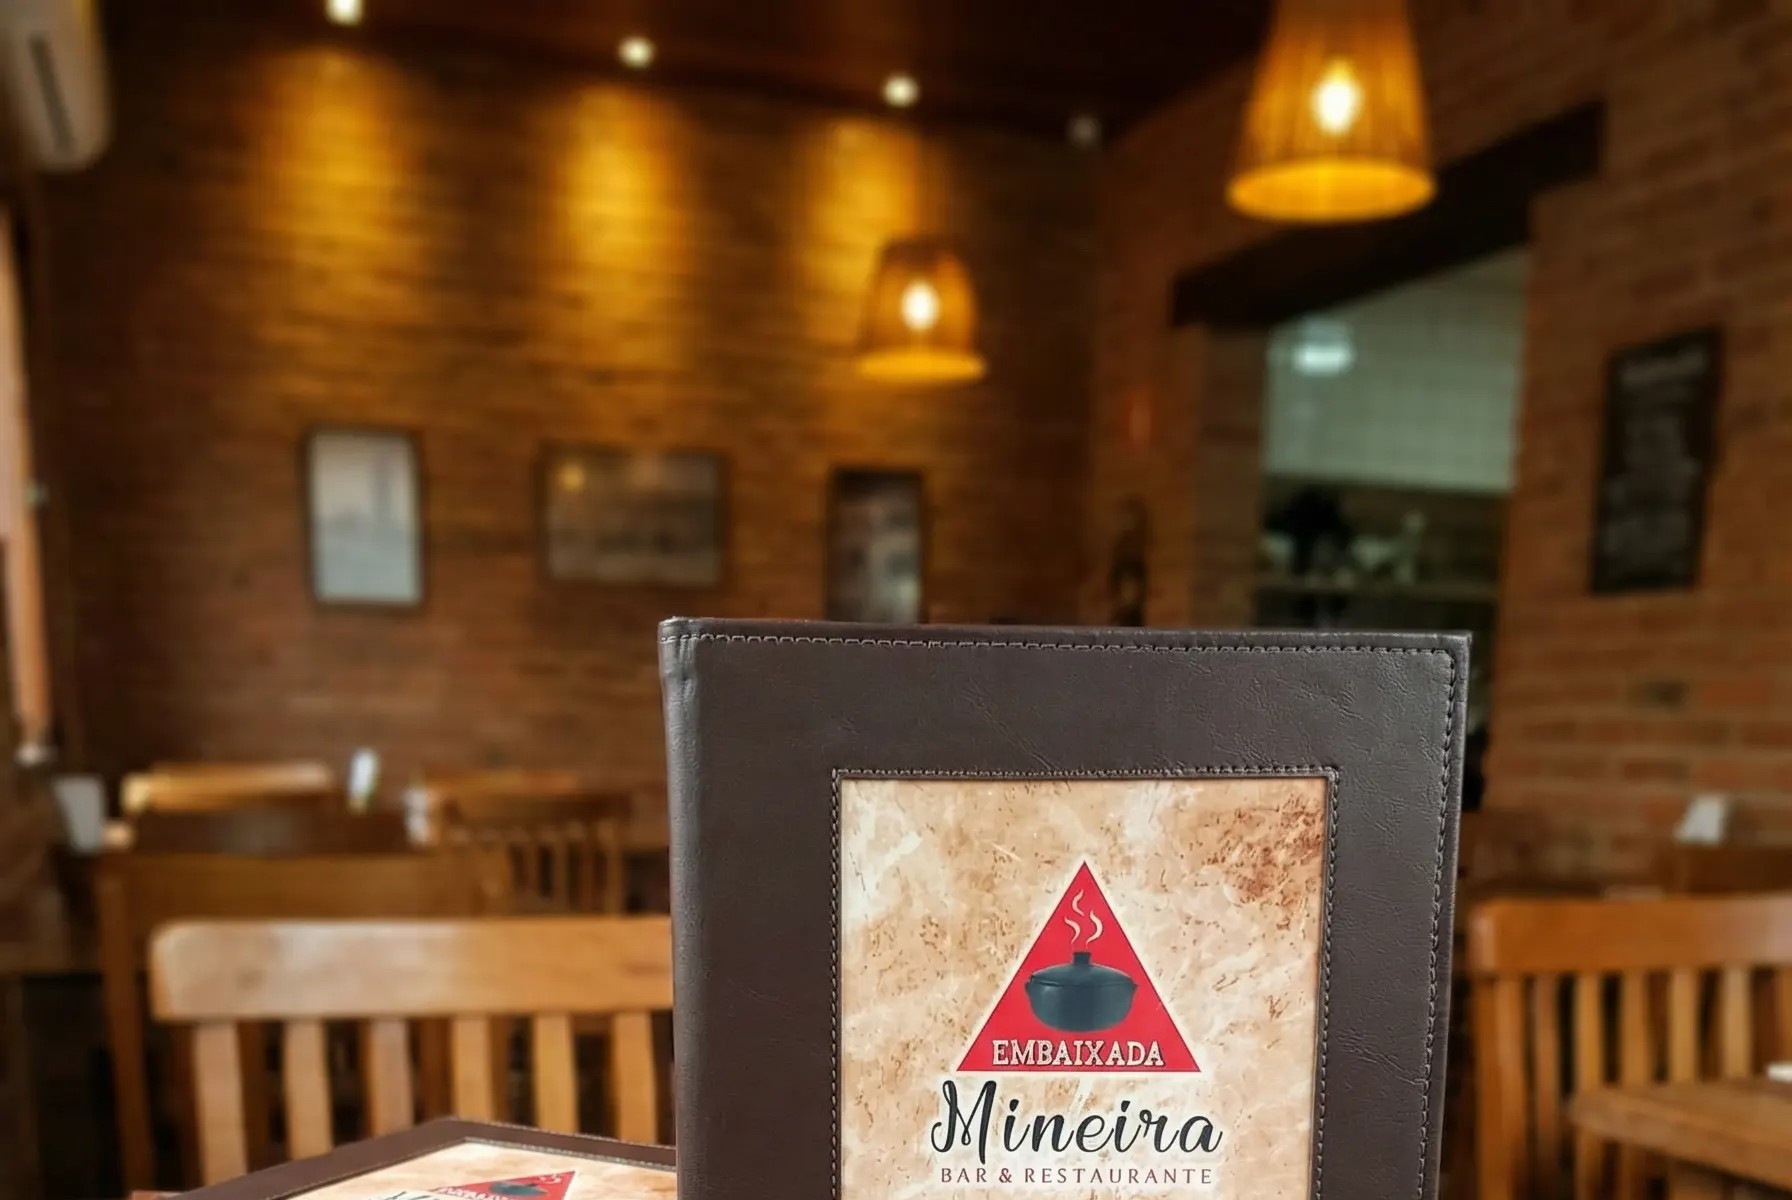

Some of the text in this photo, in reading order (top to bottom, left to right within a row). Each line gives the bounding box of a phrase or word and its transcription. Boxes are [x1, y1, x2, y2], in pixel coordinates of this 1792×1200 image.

[992, 1039, 1164, 1067] EMBAIXADA
[931, 1080, 1223, 1165] Mineira
[941, 1167, 1212, 1185] BAR & RESTAURANTE
